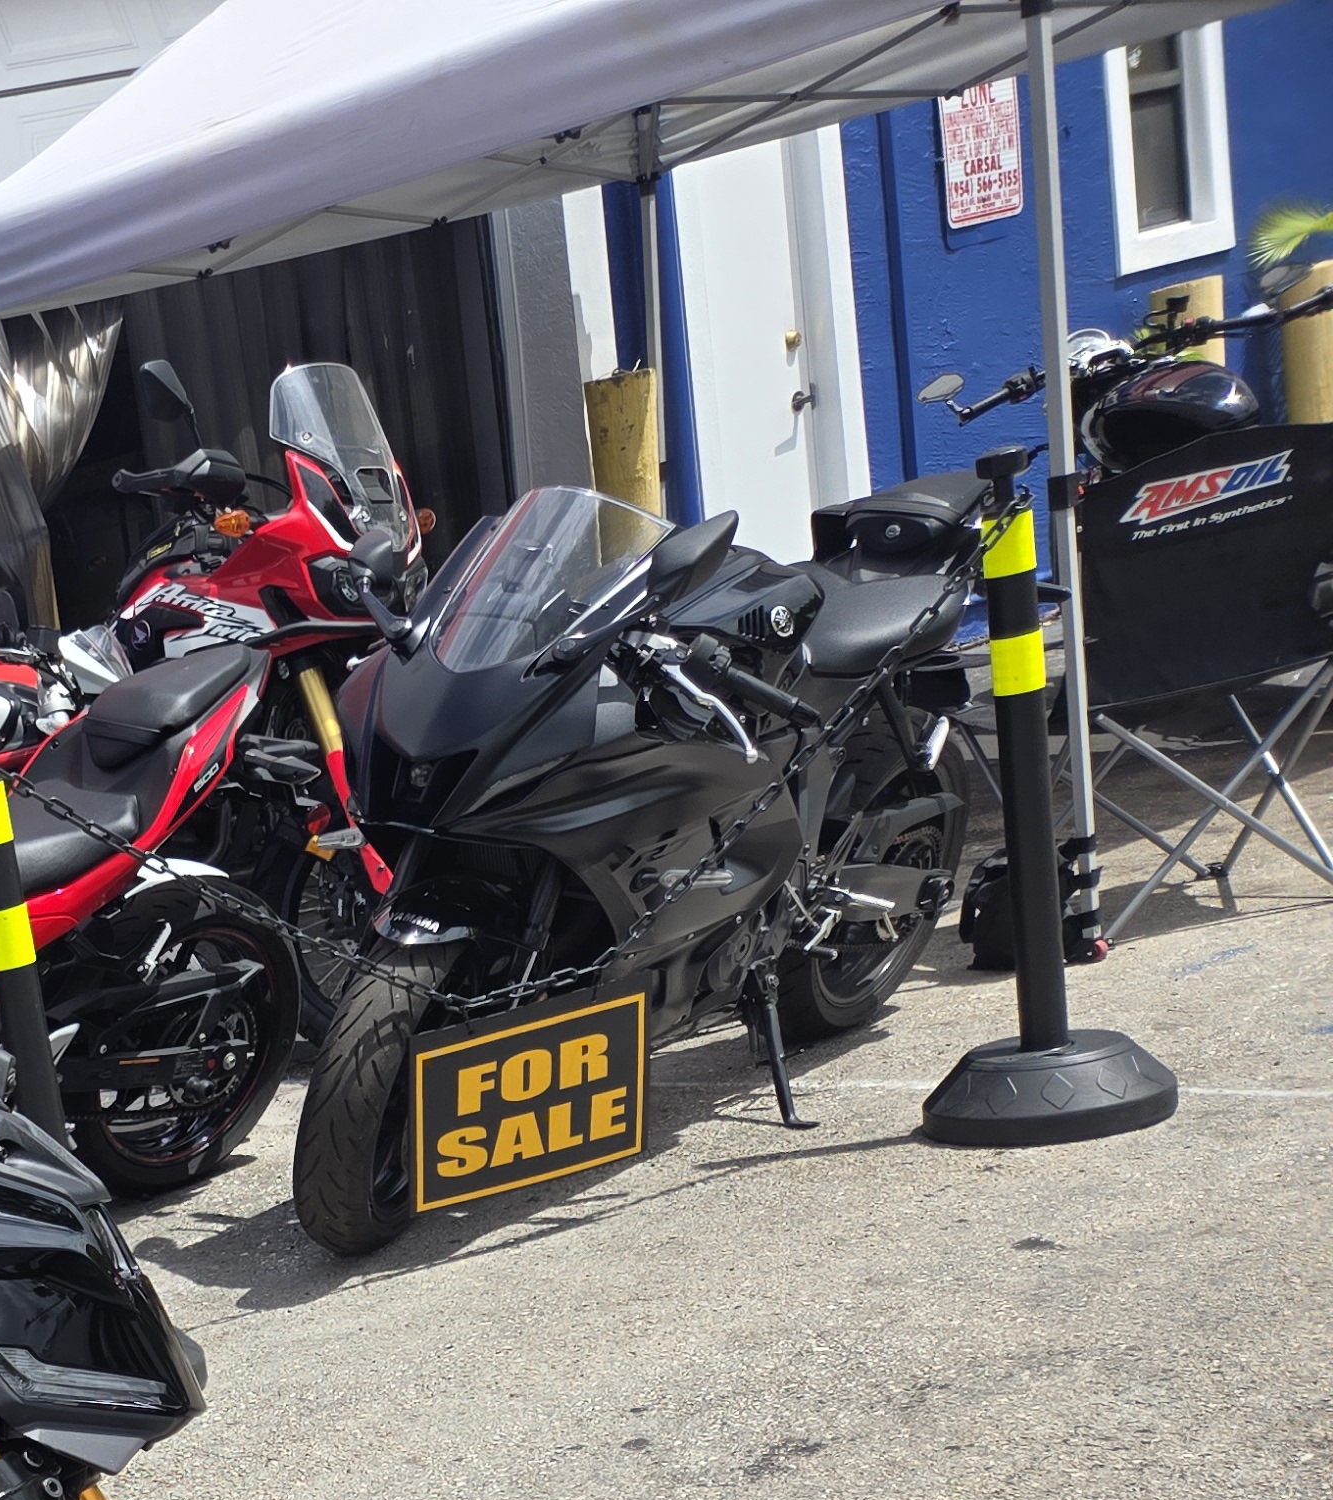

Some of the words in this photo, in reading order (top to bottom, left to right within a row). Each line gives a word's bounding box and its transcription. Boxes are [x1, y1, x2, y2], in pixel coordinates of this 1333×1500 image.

[949, 179, 974, 201] (954)
[977, 169, 1019, 194] 566-5155
[963, 154, 1002, 177] CARSAL
[1129, 453, 1286, 520] AMSOIL
[1132, 529, 1156, 541] The
[1158, 520, 1191, 535] First
[1208, 497, 1287, 524] Synthetics
[389, 911, 440, 933] YAMAHA
[457, 1033, 609, 1116] FOR
[437, 1086, 627, 1178] SALE
